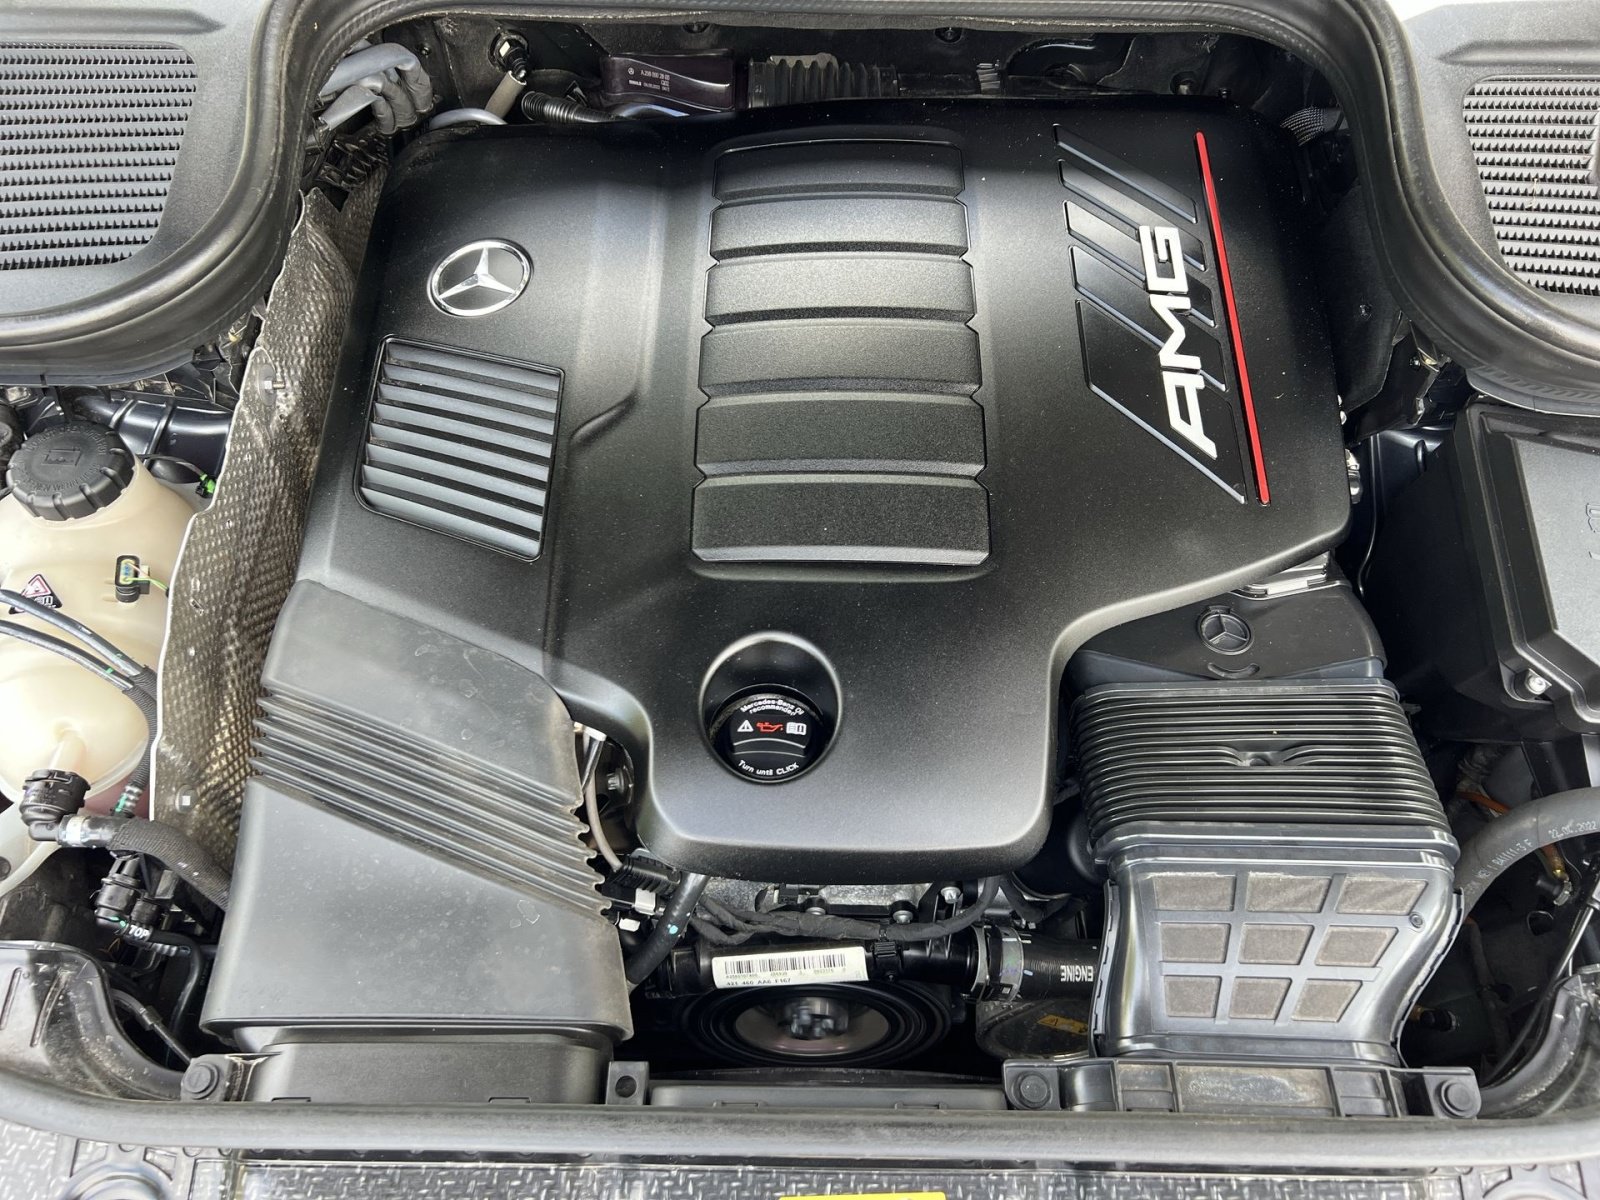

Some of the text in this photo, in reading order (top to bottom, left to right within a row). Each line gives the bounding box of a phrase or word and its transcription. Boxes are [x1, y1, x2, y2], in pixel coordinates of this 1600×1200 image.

[1139, 225, 1218, 460] AMG
[740, 699, 805, 716] Mercedes-Benz Oil
[738, 759, 800, 776] Turn until CLICK
[128, 924, 150, 938] TOP
[1060, 965, 1094, 982] ENGINE
